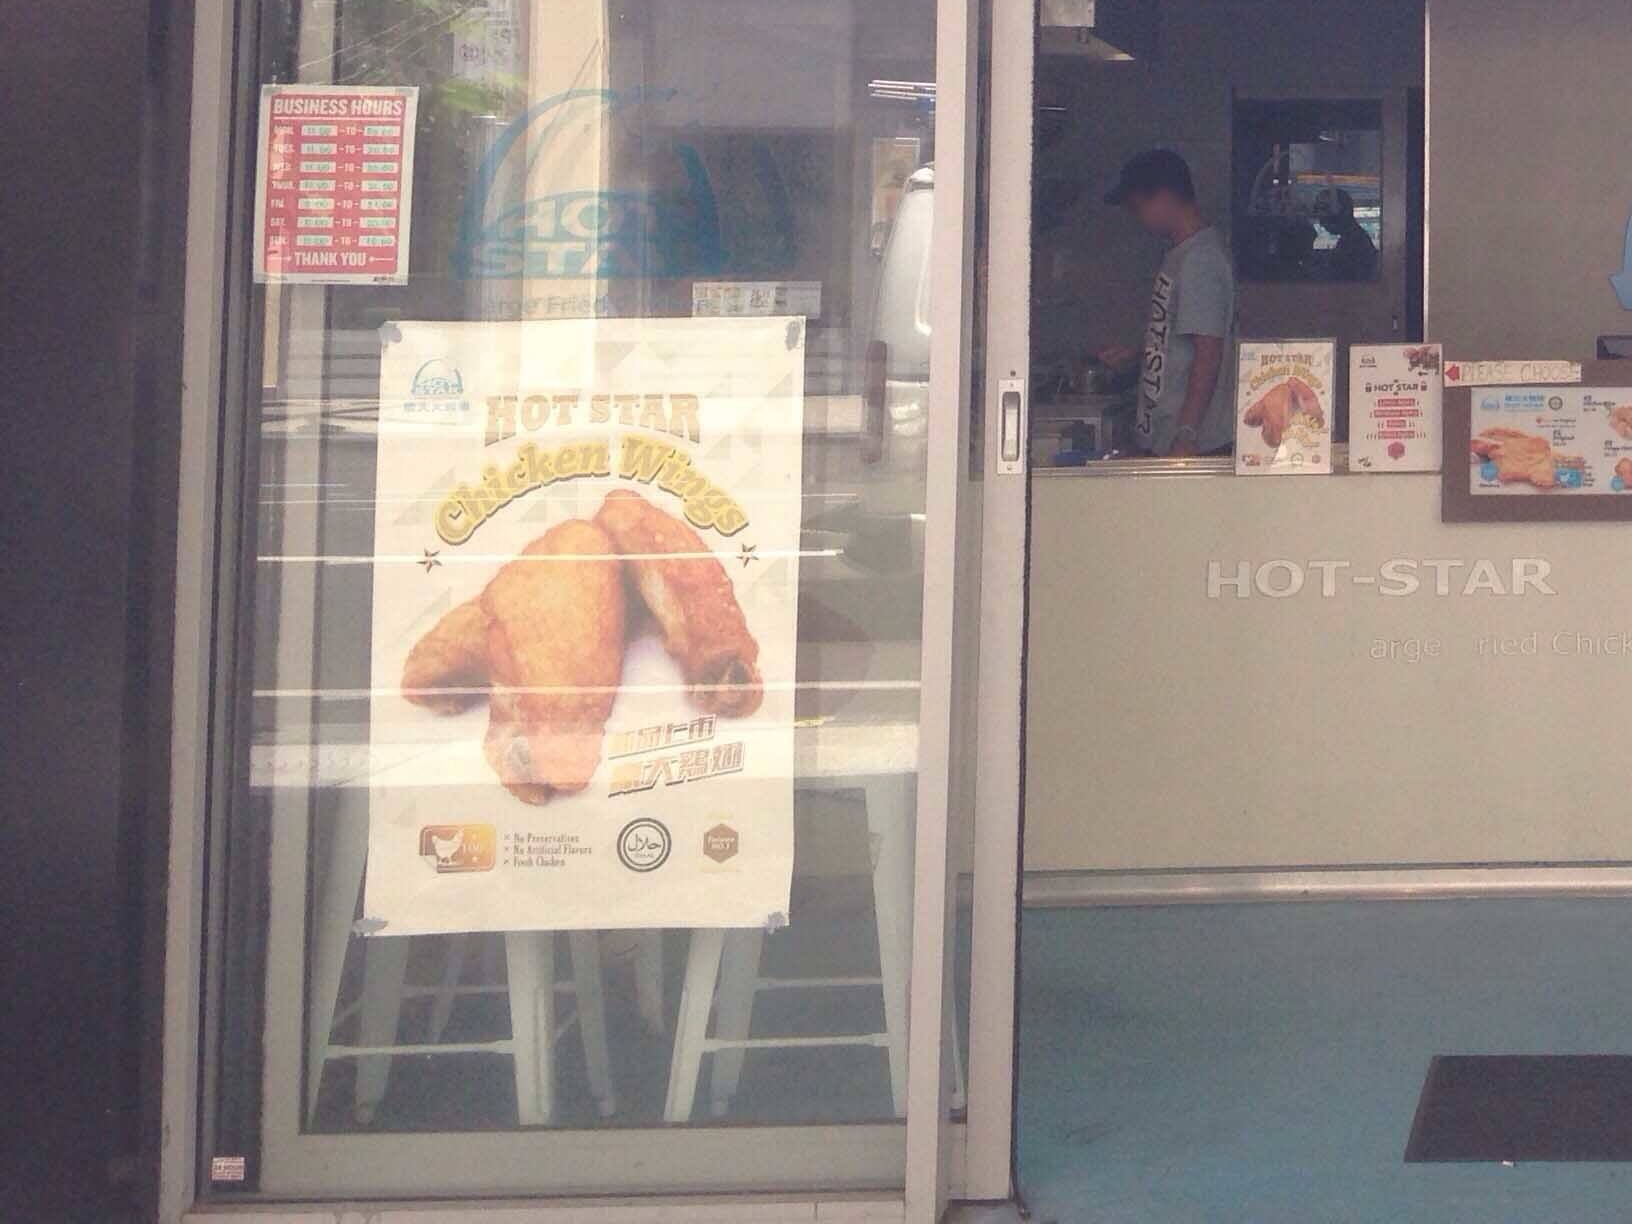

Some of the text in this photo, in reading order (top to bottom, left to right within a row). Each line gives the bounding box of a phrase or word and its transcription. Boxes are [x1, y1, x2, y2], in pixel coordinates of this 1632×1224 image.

[272, 98, 402, 116] BUSINESS HOURS
[294, 252, 367, 266] THANK YOU
[485, 393, 701, 447] HOT STAR
[434, 433, 750, 545] Chicken Wings
[1206, 558, 1557, 598] HOT-STAR
